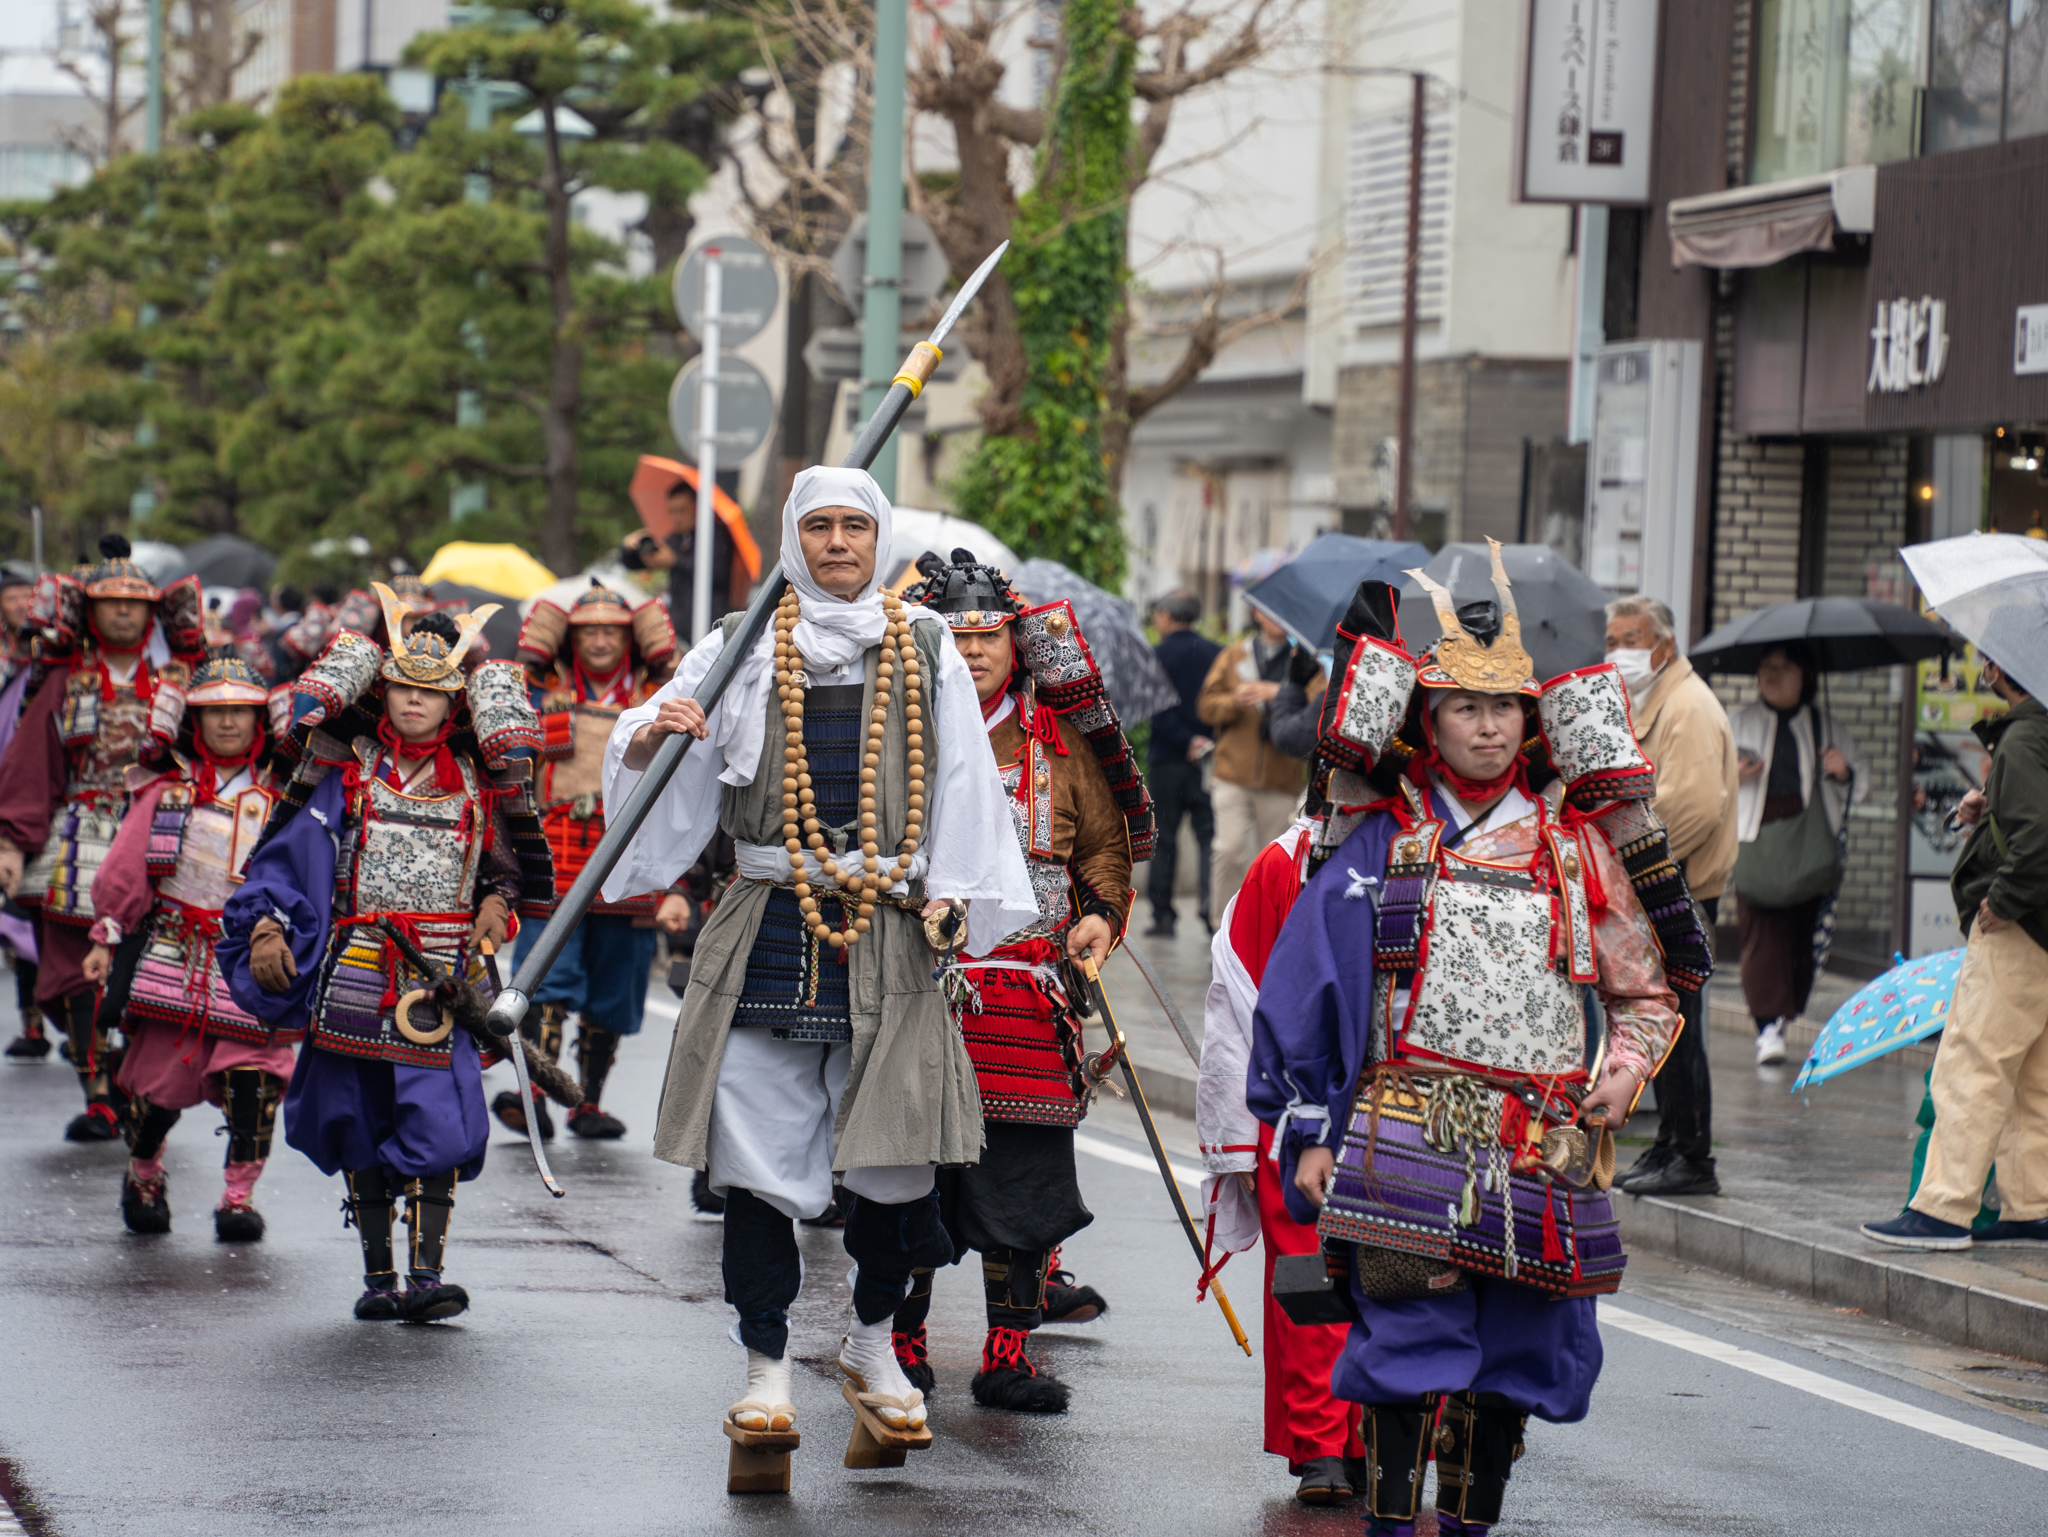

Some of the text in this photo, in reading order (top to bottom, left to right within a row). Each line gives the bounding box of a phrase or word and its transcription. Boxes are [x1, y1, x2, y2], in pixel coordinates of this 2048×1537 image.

[1557, 0, 1586, 165] ースペース鎌倉
[1591, 137, 1618, 160] 3F
